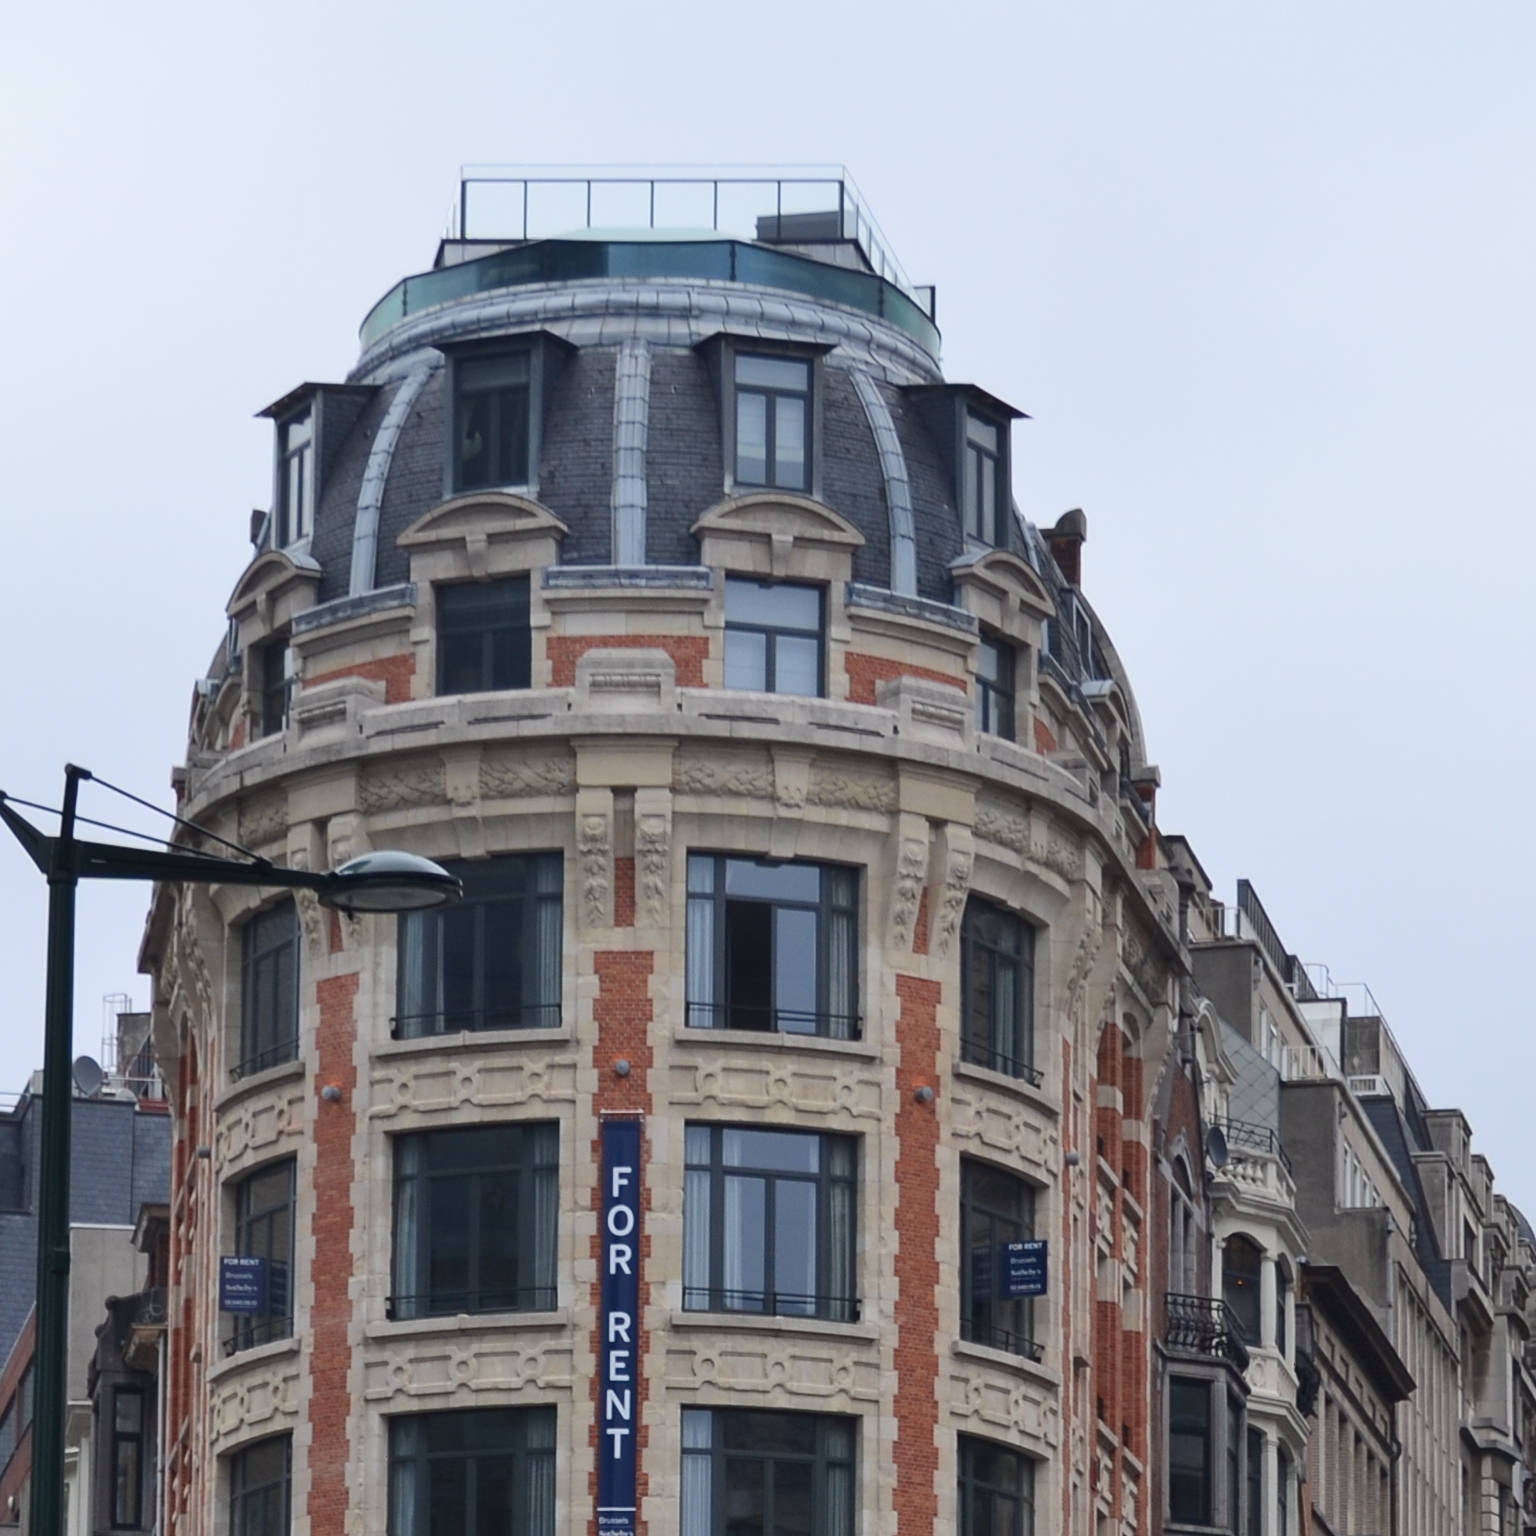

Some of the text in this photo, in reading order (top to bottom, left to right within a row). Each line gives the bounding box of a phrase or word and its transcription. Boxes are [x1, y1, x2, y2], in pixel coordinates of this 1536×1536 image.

[240, 1258, 259, 1266] RENT
[605, 1166, 635, 1459] FOR RENT
